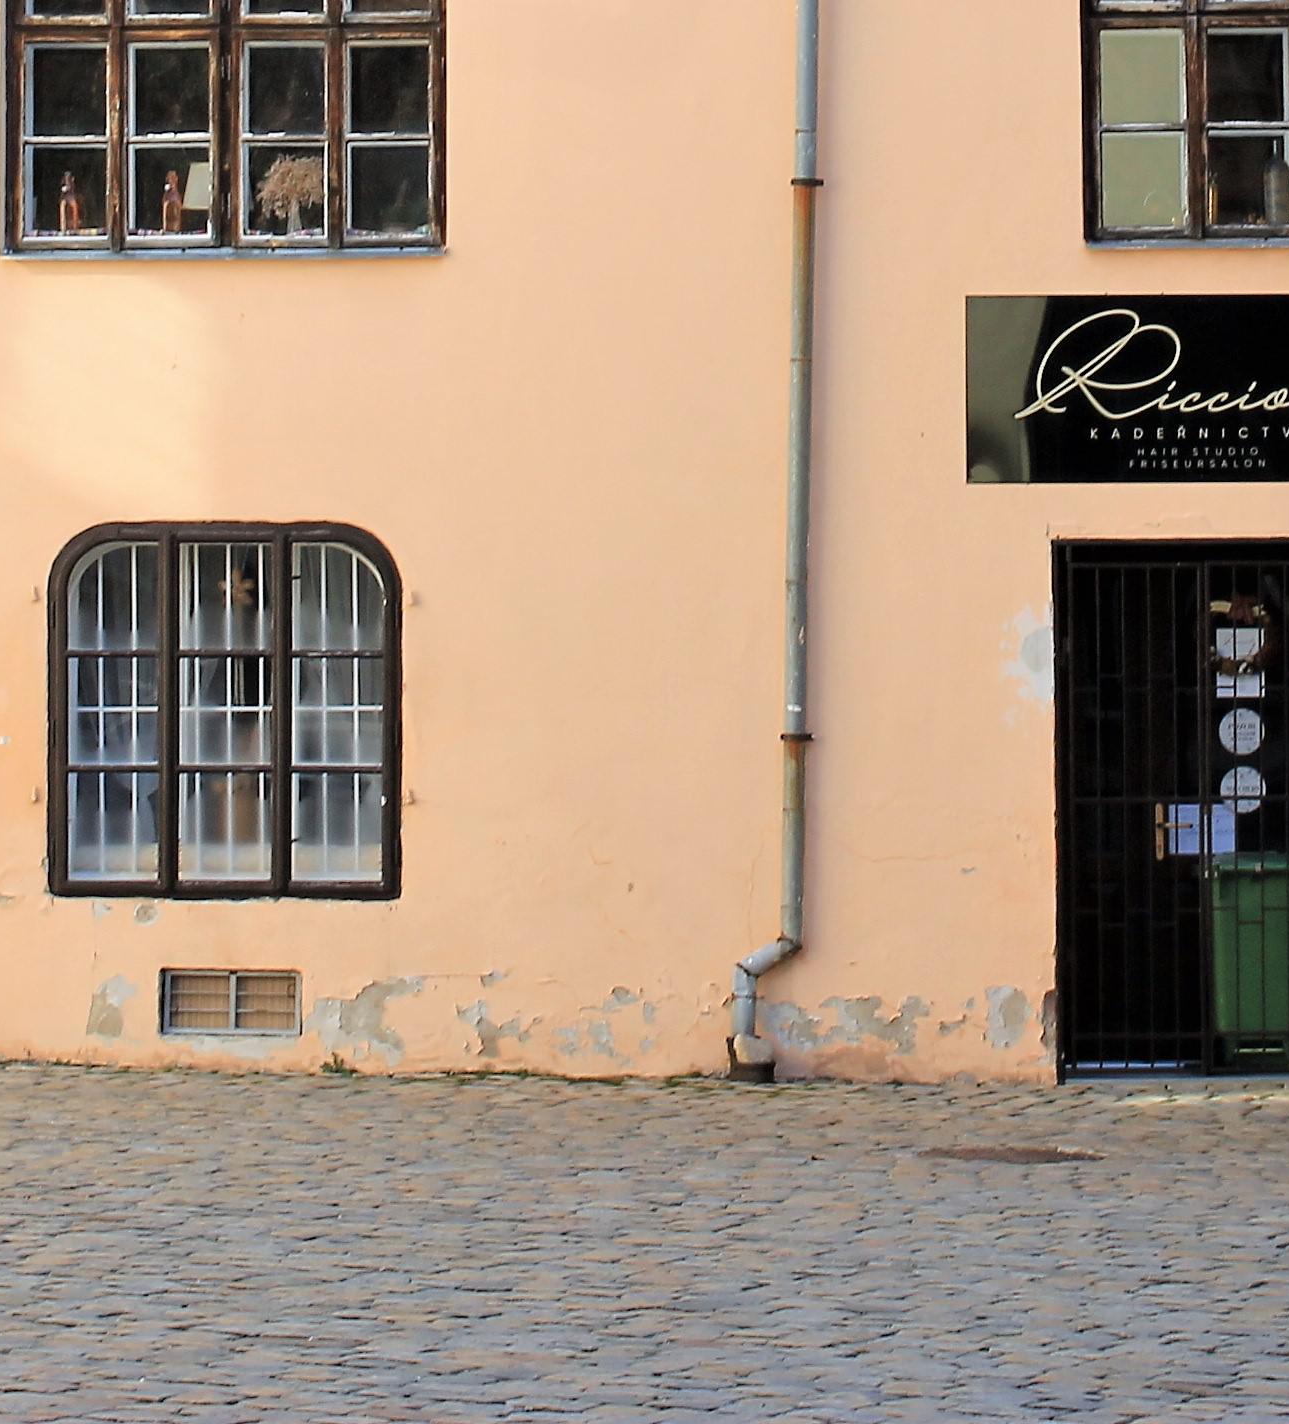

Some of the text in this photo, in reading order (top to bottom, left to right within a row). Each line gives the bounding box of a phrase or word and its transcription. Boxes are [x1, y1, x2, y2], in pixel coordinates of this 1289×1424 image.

[1136, 446, 1259, 457] HAIR STUDIO
[1128, 459, 1266, 469] FRISEURSALON
